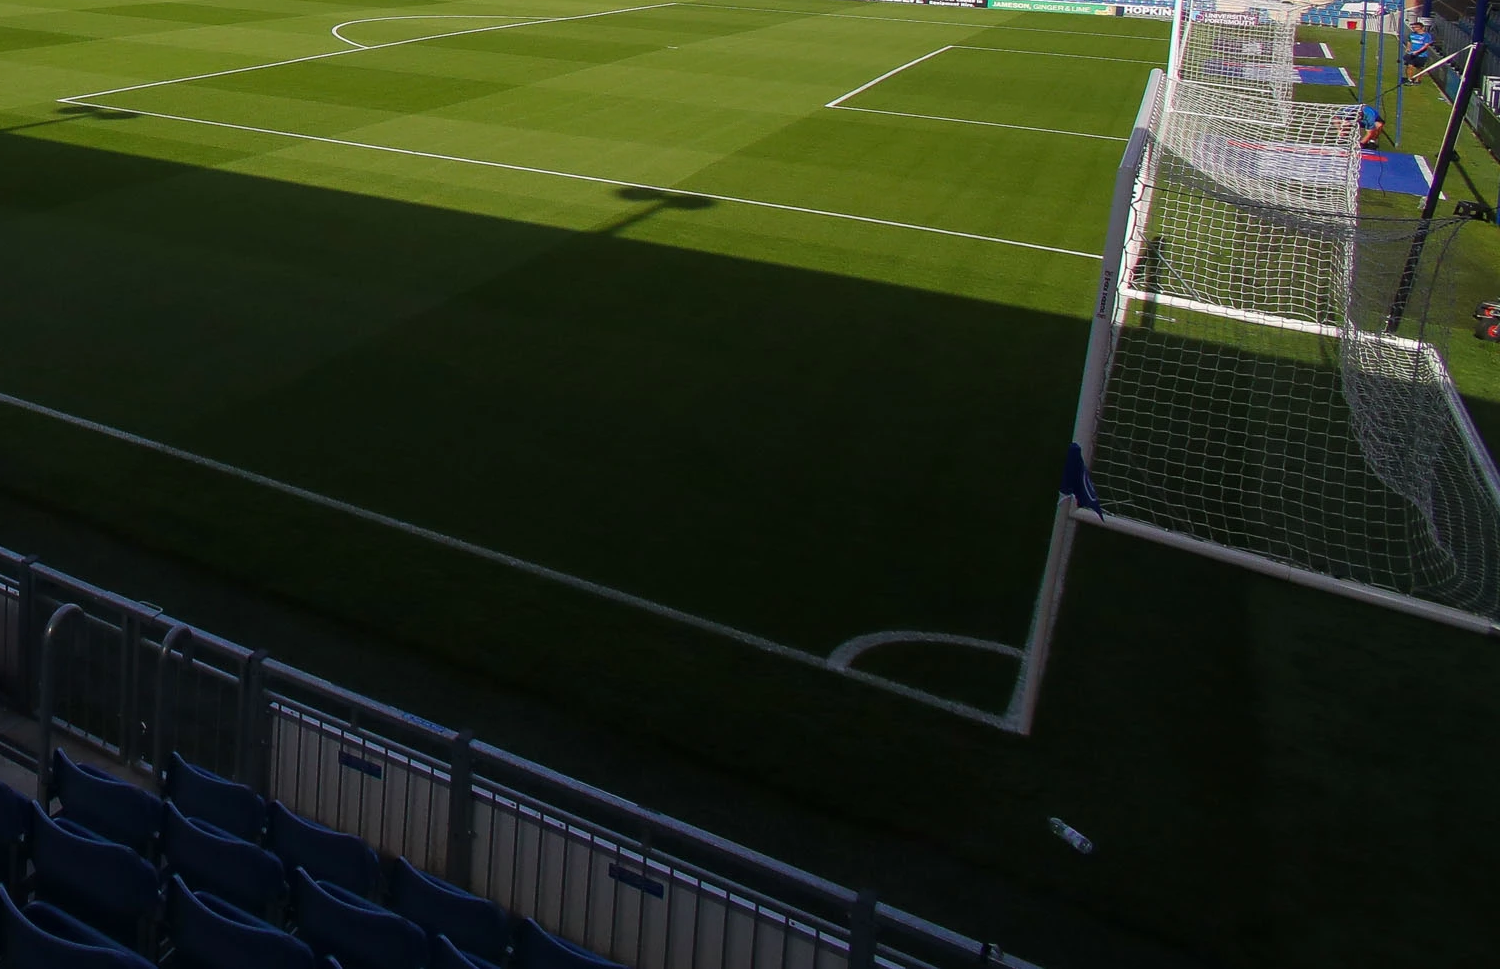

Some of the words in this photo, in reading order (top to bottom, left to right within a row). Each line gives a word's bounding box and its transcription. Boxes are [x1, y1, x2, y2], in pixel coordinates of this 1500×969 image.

[992, 1, 1032, 10] JAMESON,
[1204, 12, 1247, 20] UNIVERSITY
[1204, 18, 1255, 26] PORTSMOUTH
